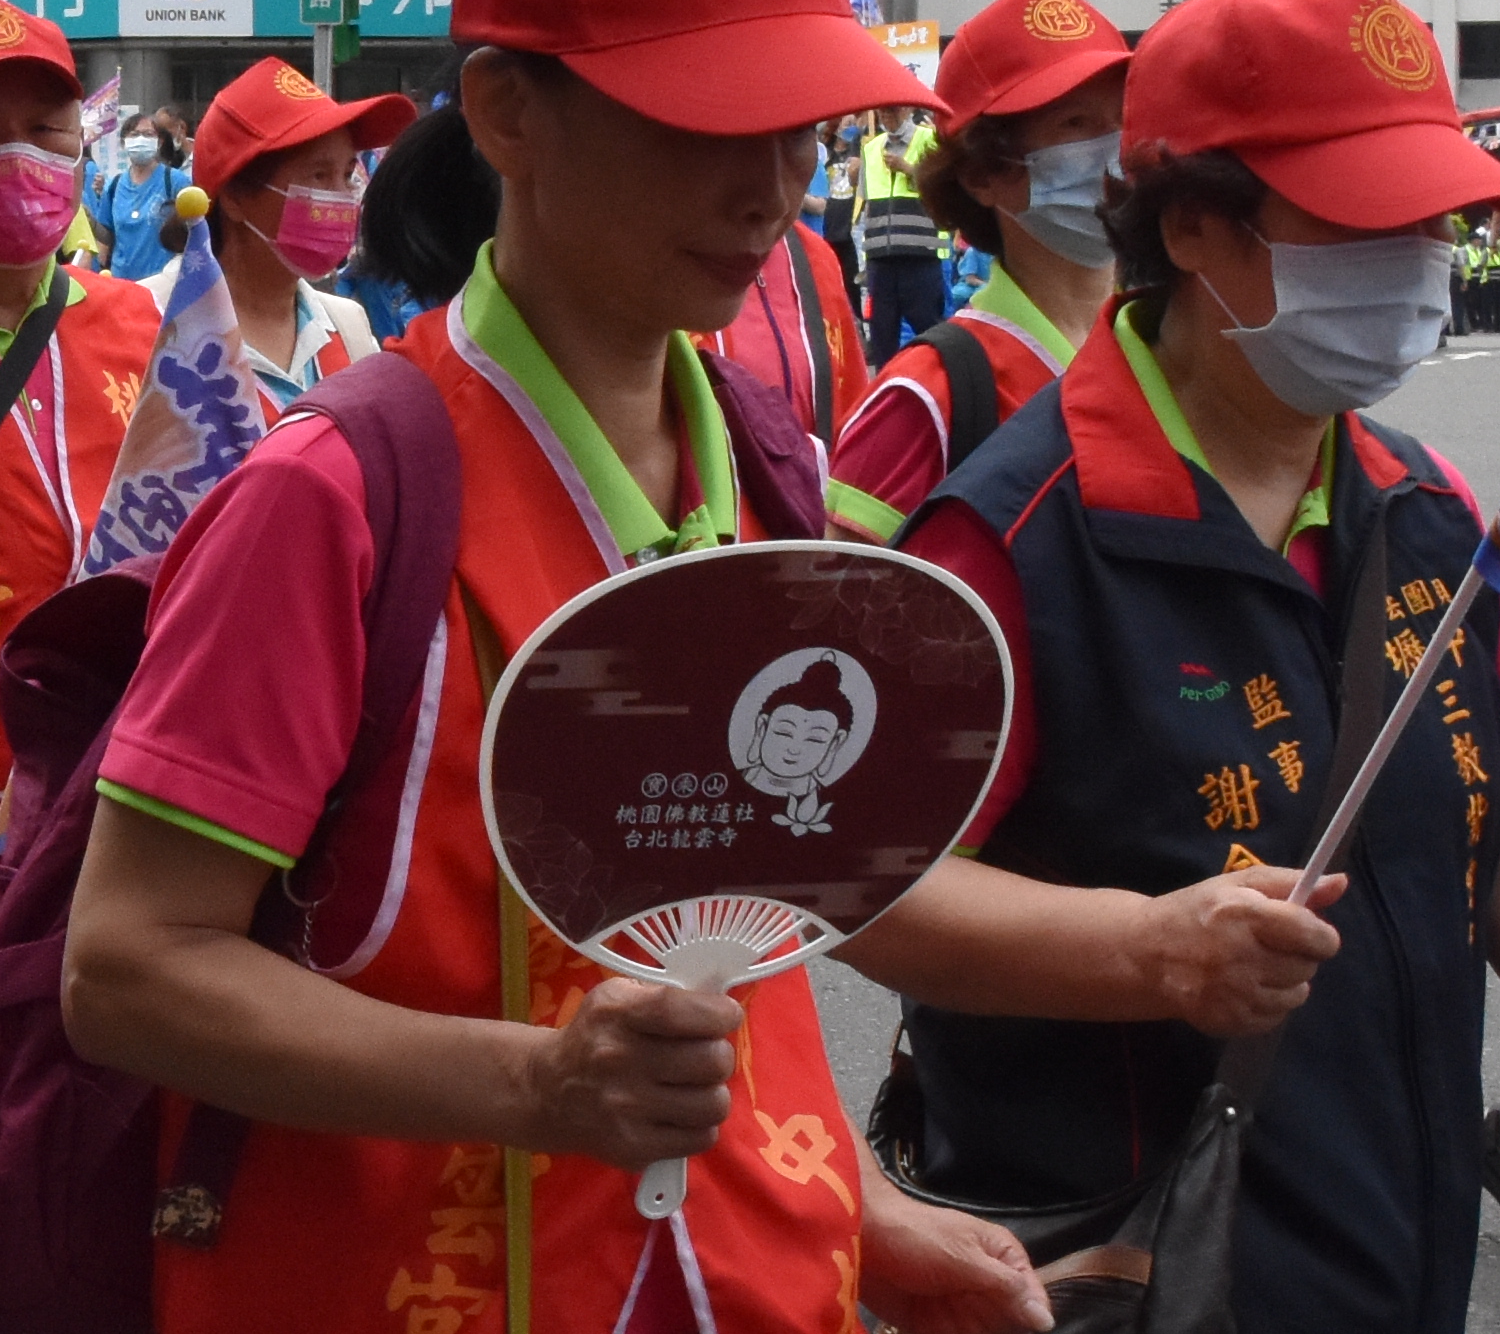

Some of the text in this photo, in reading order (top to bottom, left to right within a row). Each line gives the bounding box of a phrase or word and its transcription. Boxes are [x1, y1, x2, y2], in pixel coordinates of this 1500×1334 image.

[144, 9, 226, 22] UNION BANK
[1242, 673, 1305, 794] 監事
[614, 802, 755, 825] 桃園佛教蓮社
[624, 826, 738, 850] 台北龍雲寺
